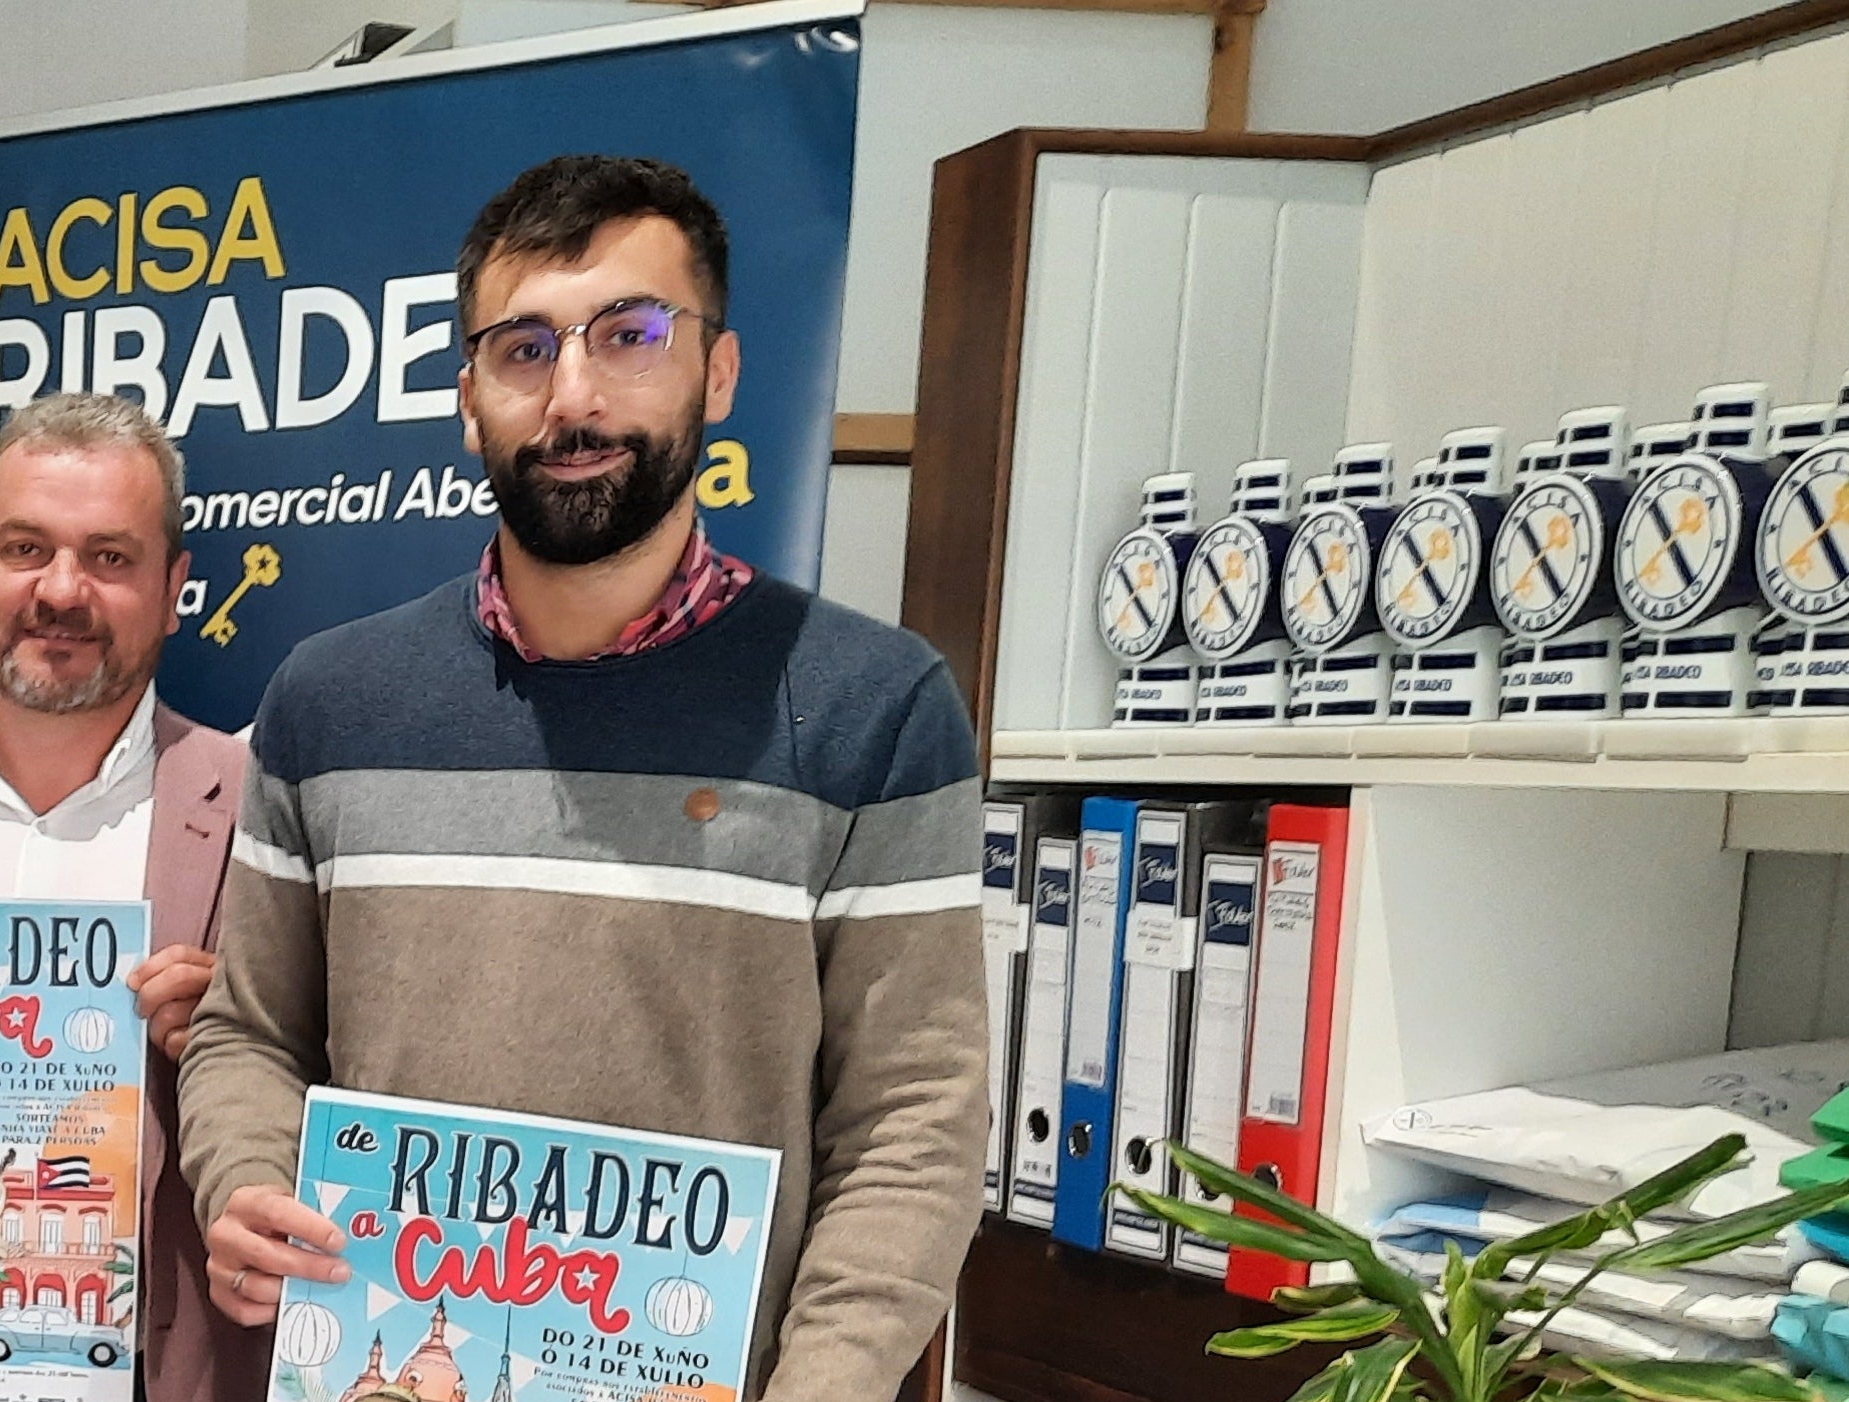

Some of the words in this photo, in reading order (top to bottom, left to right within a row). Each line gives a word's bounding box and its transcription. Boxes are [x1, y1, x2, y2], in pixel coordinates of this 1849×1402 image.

[181, 469, 394, 533] omercial
[392, 465, 498, 523] Abe
[10, 1078, 28, 1090] 14
[35, 1079, 56, 1091] DE
[62, 1079, 115, 1092] XULLO
[20, 1062, 37, 1075] 21
[46, 1062, 67, 1075] DE
[335, 1122, 379, 1154] de
[387, 1124, 731, 1257] RIBADEO
[350, 1211, 384, 1239] a
[393, 1214, 631, 1333] Cuba
[542, 1328, 575, 1347] DO
[583, 1334, 605, 1352] 21
[617, 1340, 645, 1359] DE
[568, 1352, 591, 1371] 14
[600, 1358, 628, 1376] DE
[636, 1364, 705, 1388] XULLO
